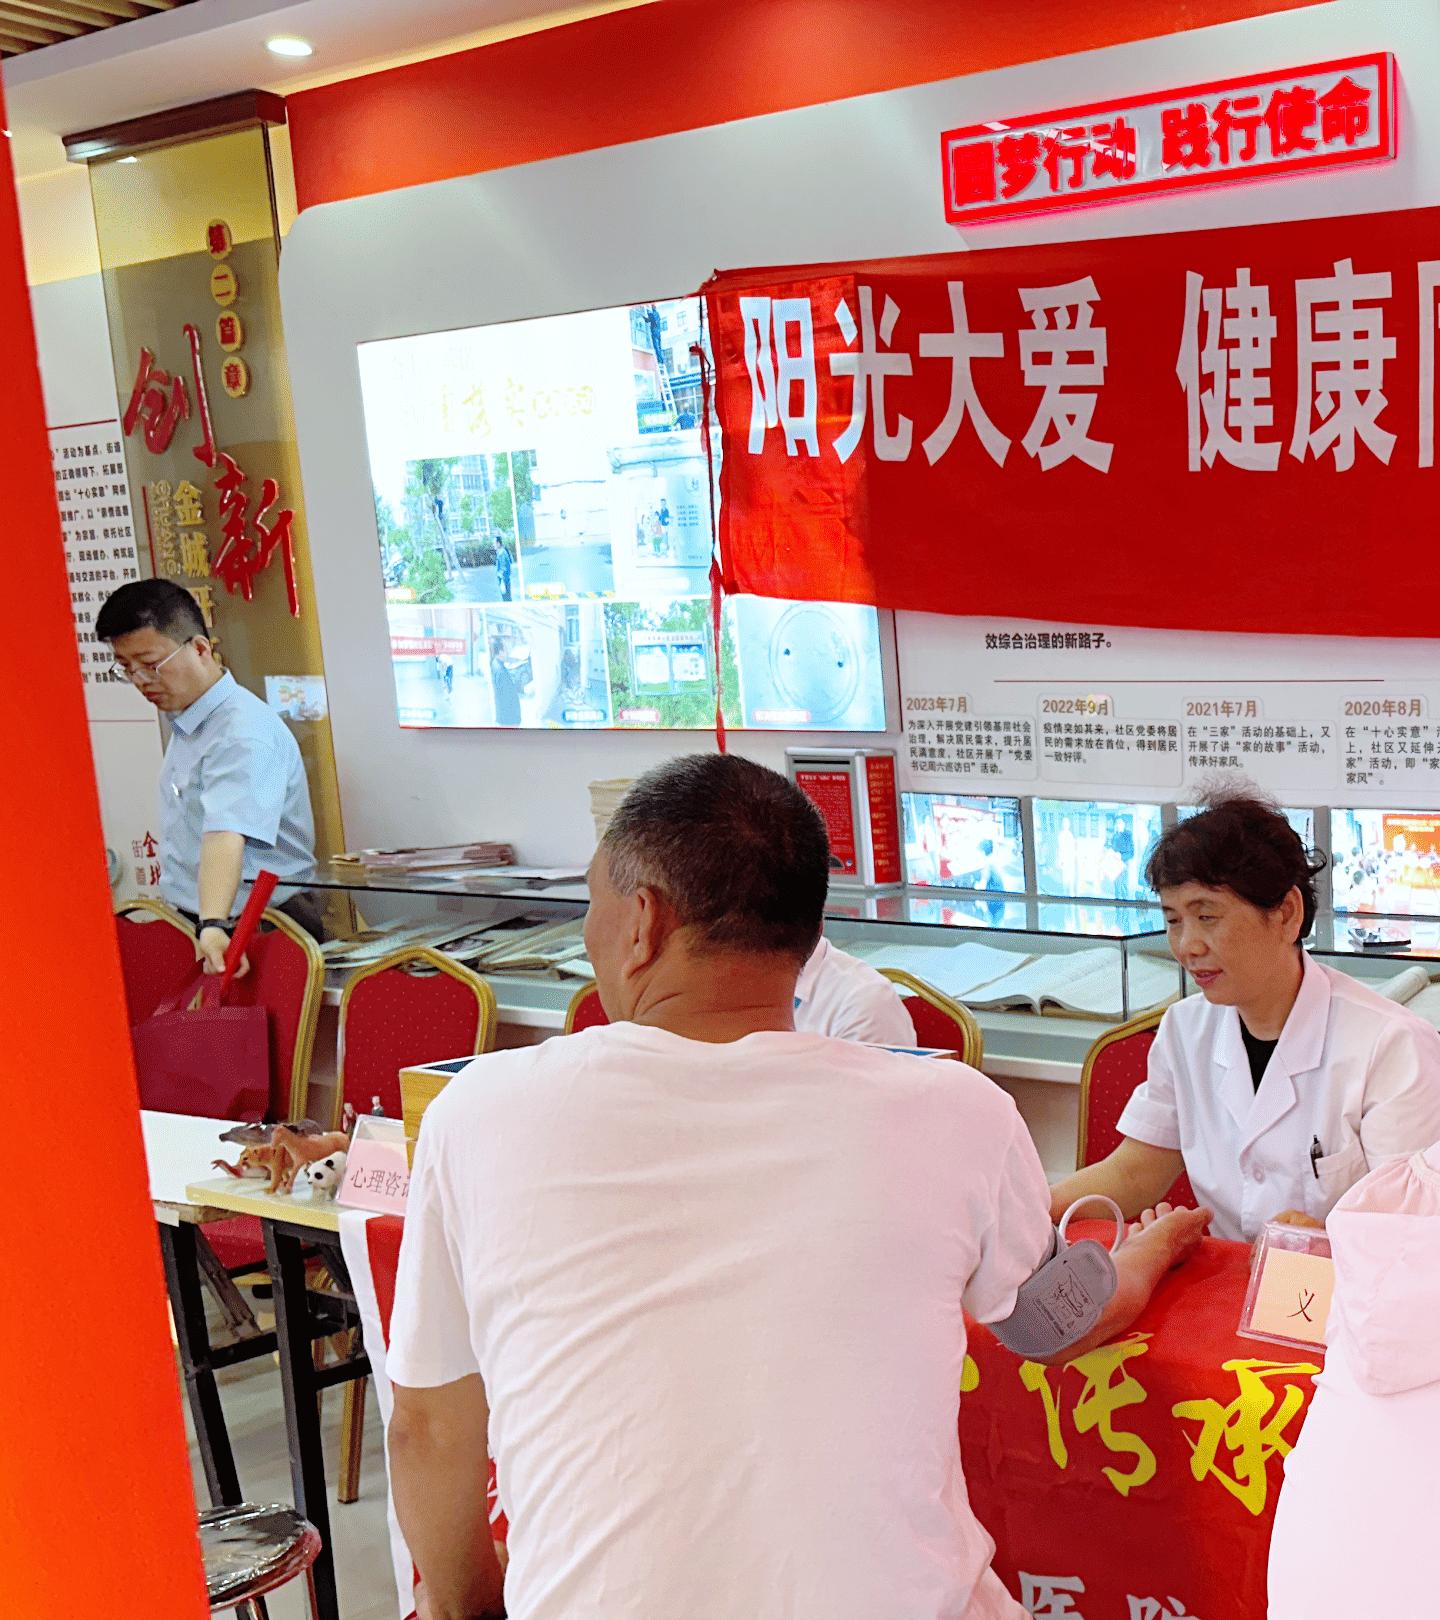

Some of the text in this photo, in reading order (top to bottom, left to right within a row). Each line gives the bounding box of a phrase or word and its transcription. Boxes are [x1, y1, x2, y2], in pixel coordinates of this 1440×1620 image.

[952, 76, 1371, 207] 圆梦行动 践行使命
[208, 223, 242, 391] 第二篇章
[741, 277, 1113, 474] 阳光大爱
[985, 632, 1112, 649] 效综合治理的新路子。
[906, 697, 967, 713] 2023年7月
[1043, 699, 1108, 716] 2022年9月
[1186, 700, 1257, 718] 2021年7月
[1344, 699, 1421, 717] 2020年8月
[1044, 751, 1087, 764] 一致好评。
[1188, 756, 1244, 769] 传承好家风。
[1346, 772, 1385, 786] 家风”。
[1287, 1288, 1316, 1322] 义
[960, 1333, 1321, 1516] 传承
